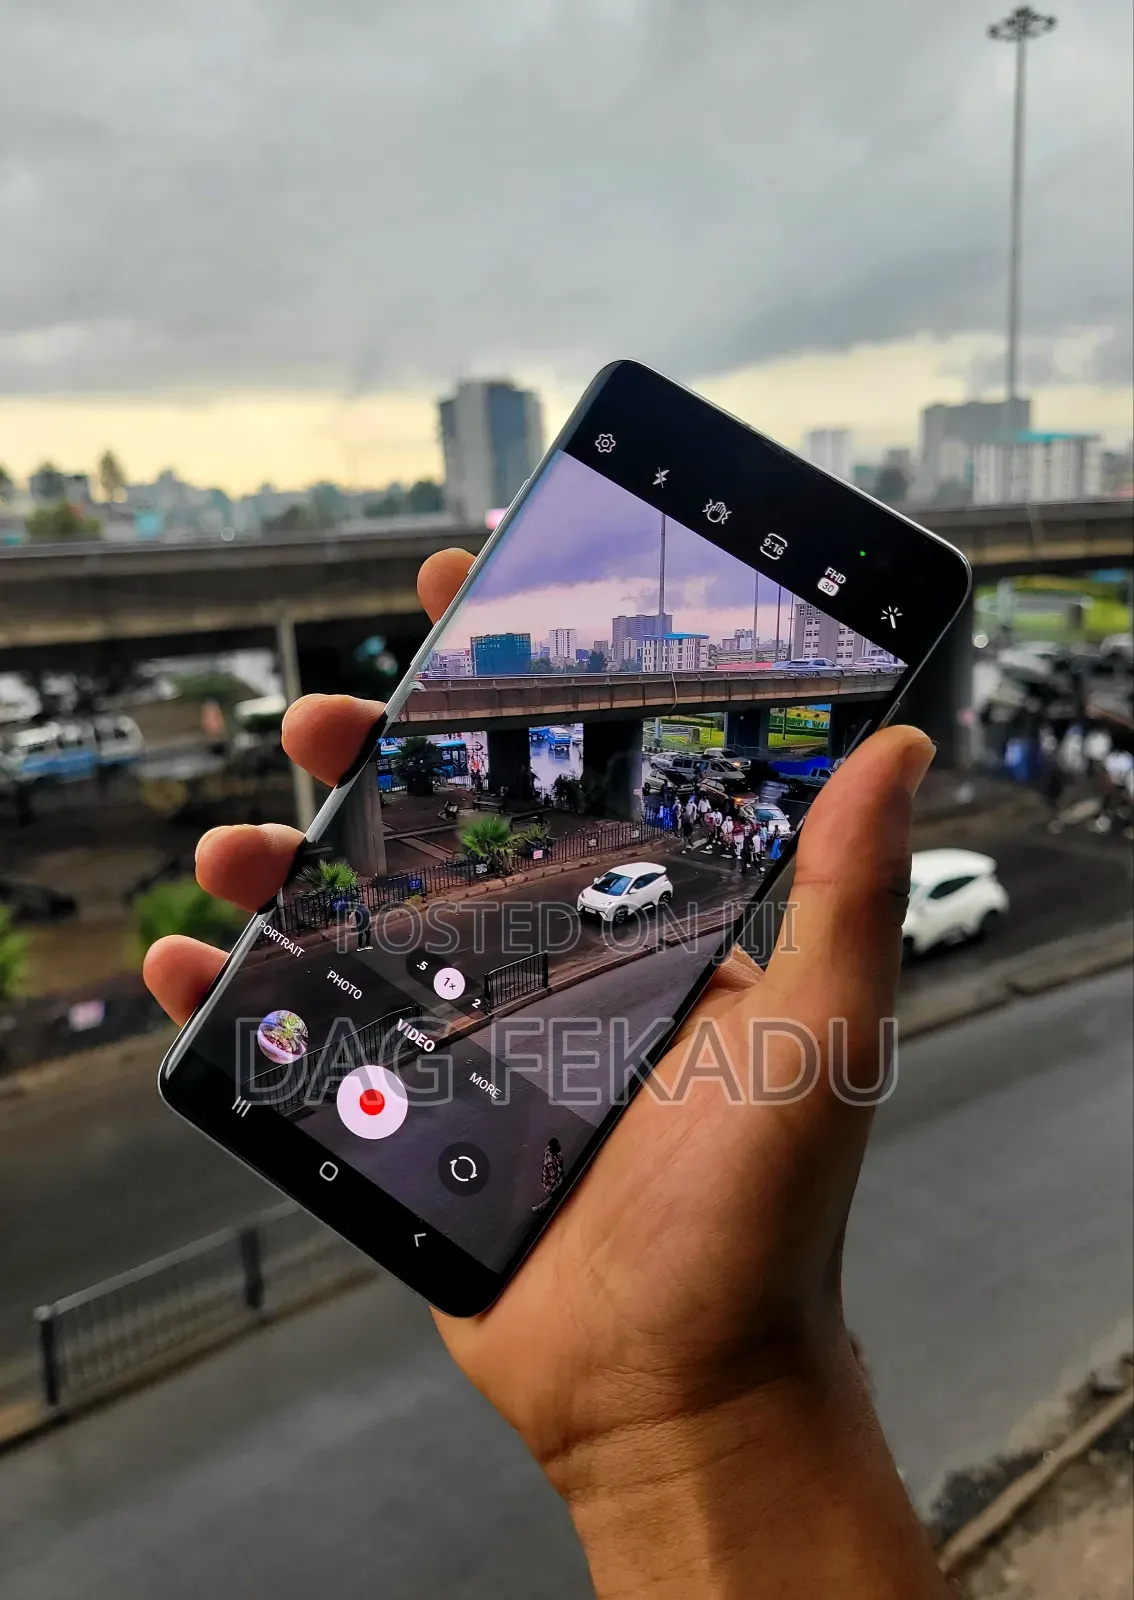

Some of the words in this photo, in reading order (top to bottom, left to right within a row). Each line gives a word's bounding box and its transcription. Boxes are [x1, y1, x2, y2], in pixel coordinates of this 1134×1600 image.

[763, 538, 785, 555] 9:16
[825, 567, 846, 584] FHD
[258, 920, 305, 957] PORTRAIT
[416, 960, 429, 971] .5
[326, 970, 363, 1000] PHOTO
[471, 998, 481, 1008] 2
[396, 1018, 435, 1053] VIDEO
[469, 1072, 501, 1099] MORE
